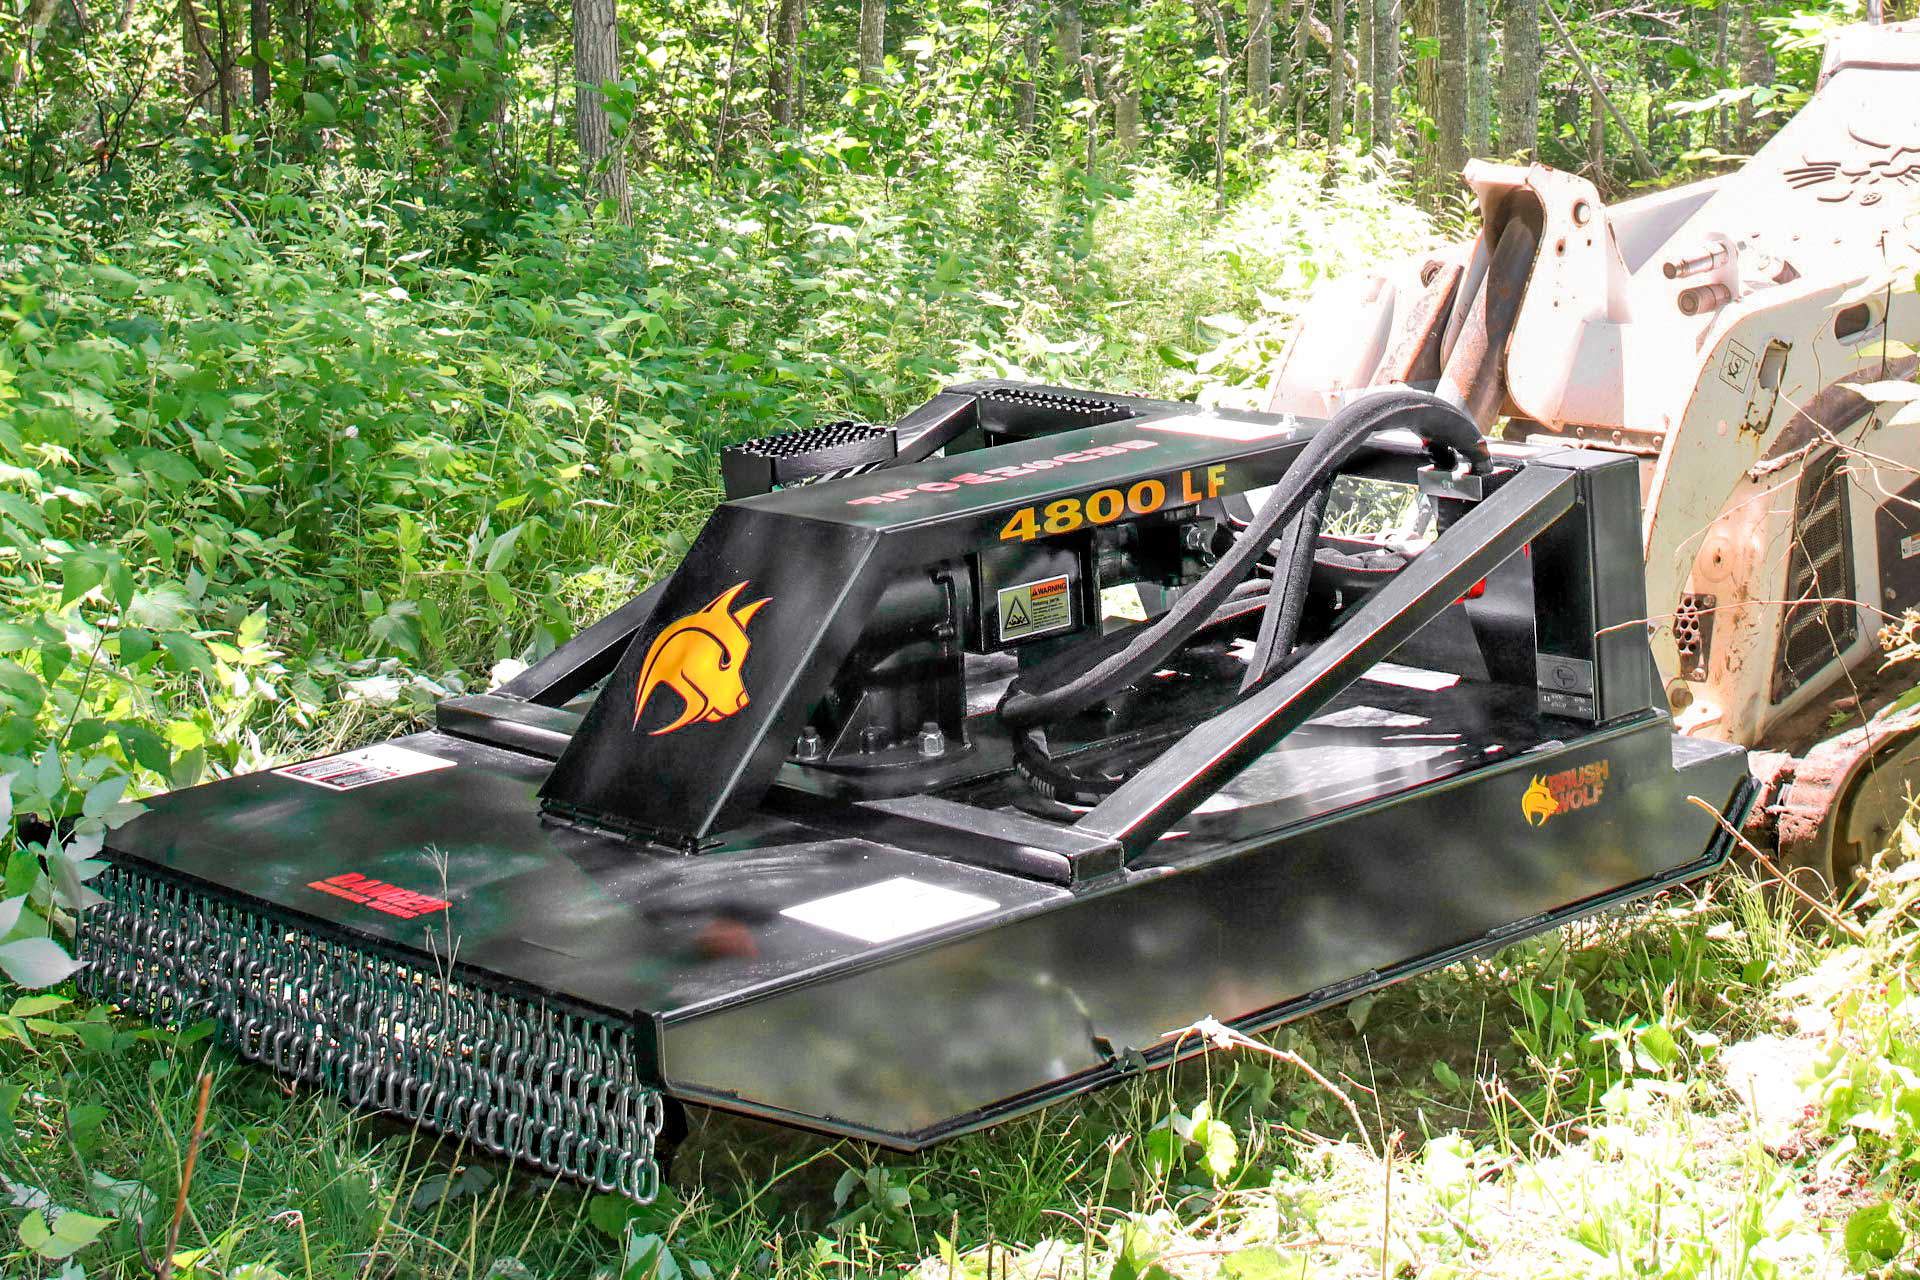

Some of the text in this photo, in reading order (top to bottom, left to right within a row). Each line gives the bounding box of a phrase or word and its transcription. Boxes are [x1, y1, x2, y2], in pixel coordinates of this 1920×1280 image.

[1000, 464, 1226, 541] 4800 LF
[1036, 582, 1067, 595] WARNING
[1549, 759, 1609, 794] BRUSH
[1553, 781, 1604, 814] WOLF
